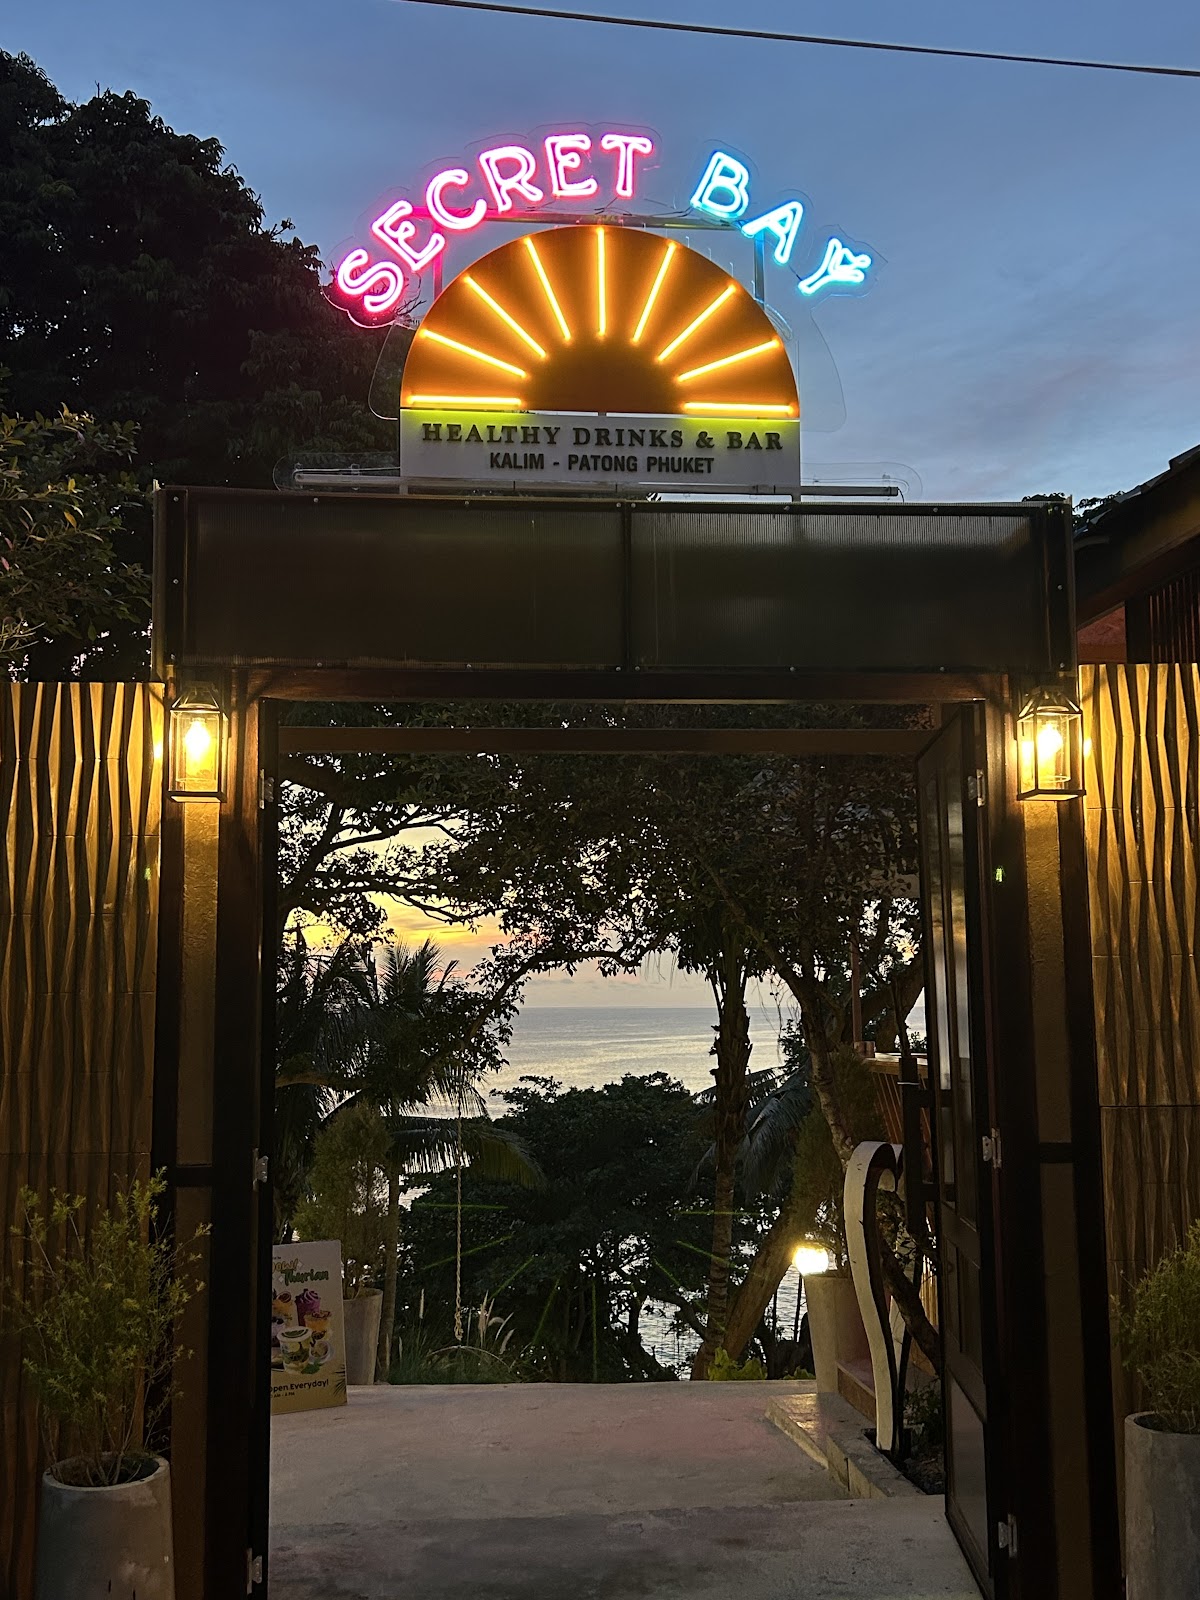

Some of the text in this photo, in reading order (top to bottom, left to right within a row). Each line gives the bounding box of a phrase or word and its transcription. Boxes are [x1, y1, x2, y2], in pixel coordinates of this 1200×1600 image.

[337, 134, 872, 313] SECRET BAY
[422, 423, 784, 451] HEALTHY DRINKS & BAR
[489, 453, 545, 470] KALIM
[568, 455, 638, 473] PATONG
[646, 456, 715, 474] PHUKET
[290, 1379, 329, 1390] Everyday!
